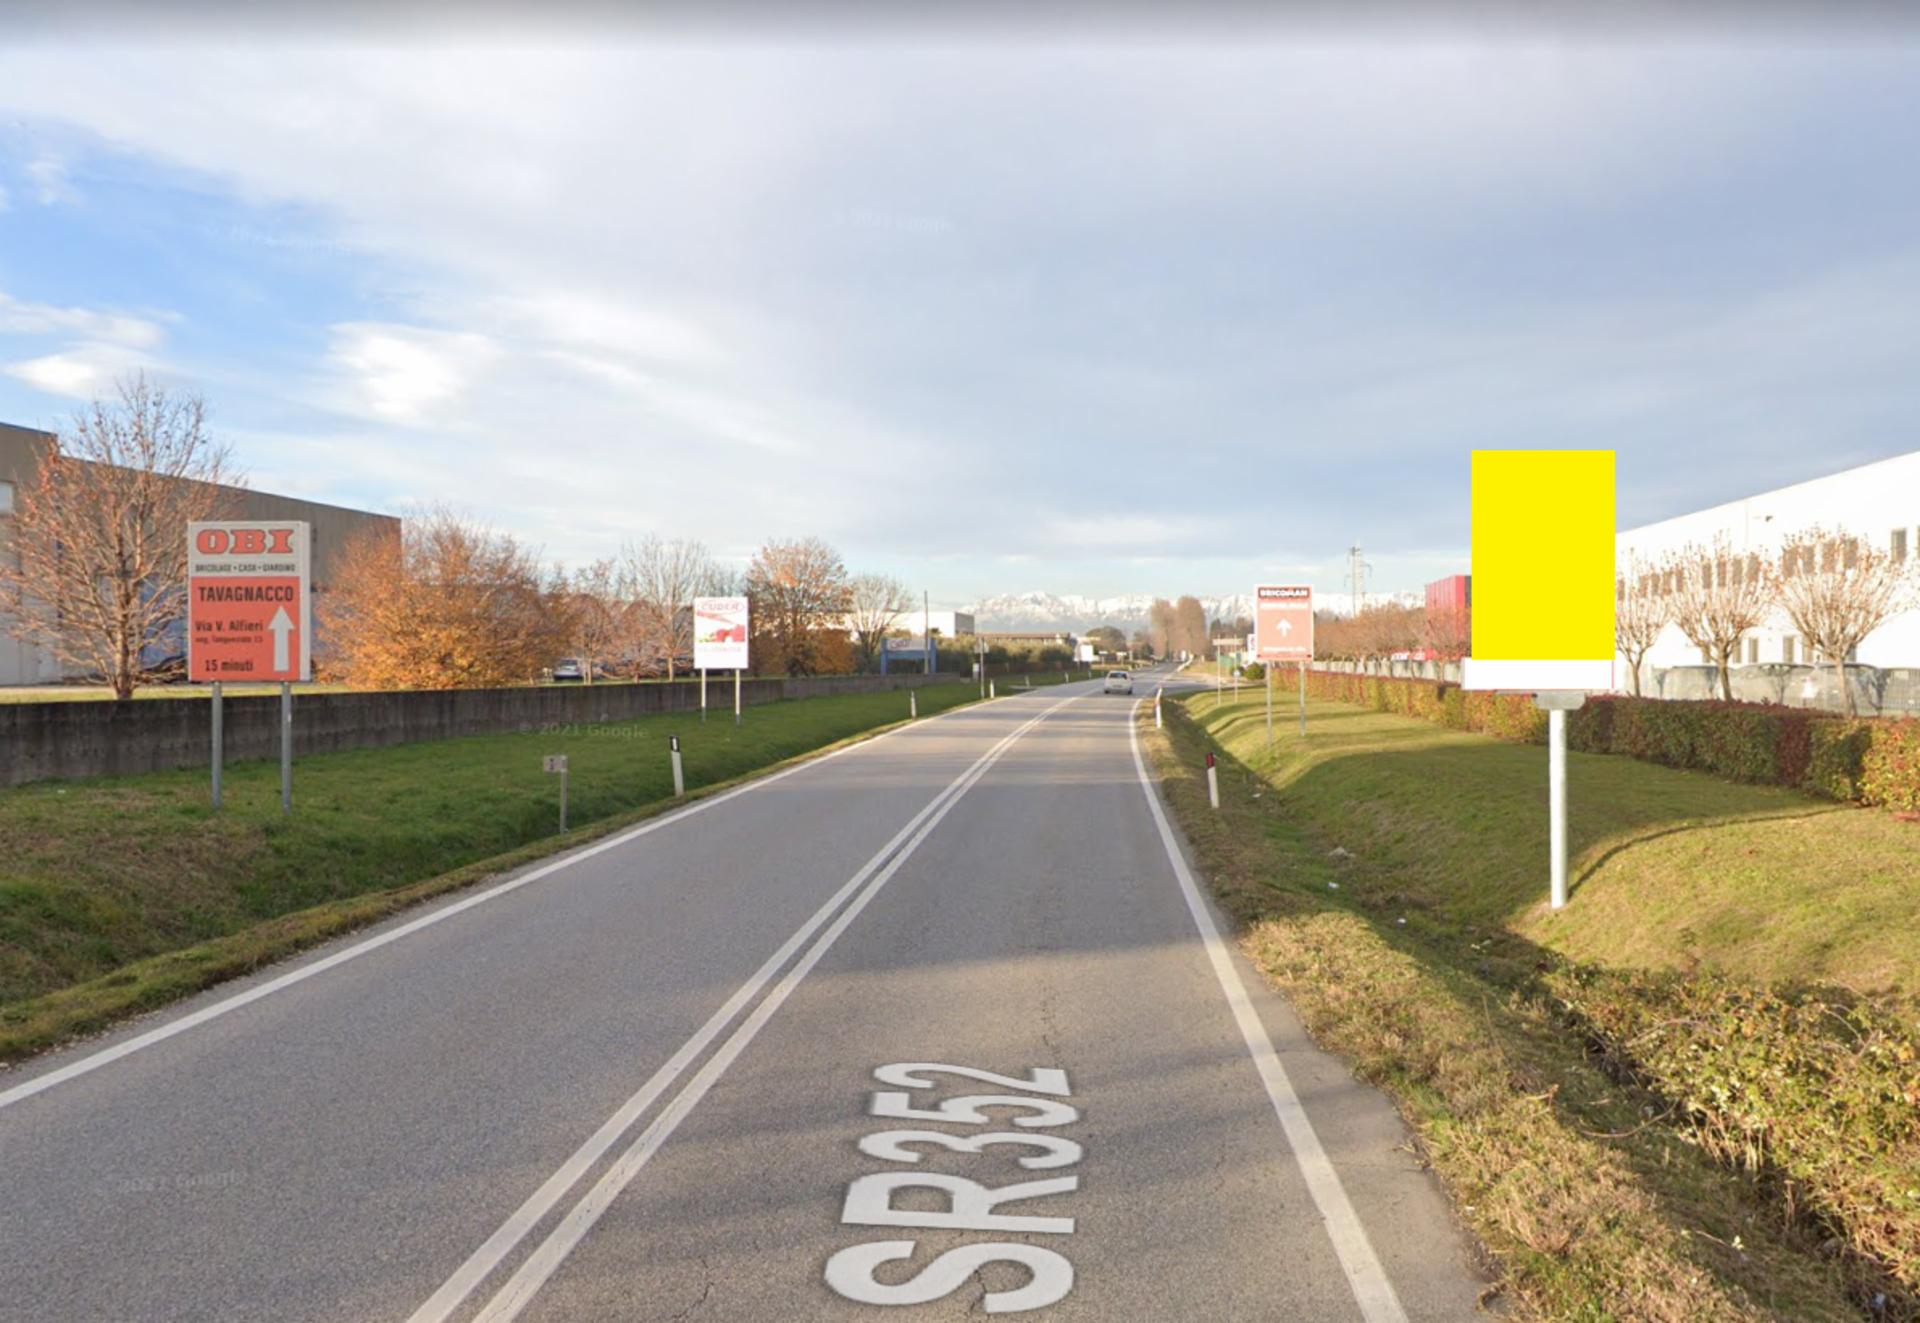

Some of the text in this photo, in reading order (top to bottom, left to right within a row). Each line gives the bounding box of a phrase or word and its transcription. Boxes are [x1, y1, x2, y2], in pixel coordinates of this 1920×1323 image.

[196, 529, 294, 555] OBI
[195, 564, 231, 572] BRICOLAGE
[198, 586, 294, 602] TAVAGNACCO
[195, 619, 263, 632] Via V. Alfieri
[205, 658, 253, 672] 15 minuti
[824, 1062, 1083, 1313] SR352
